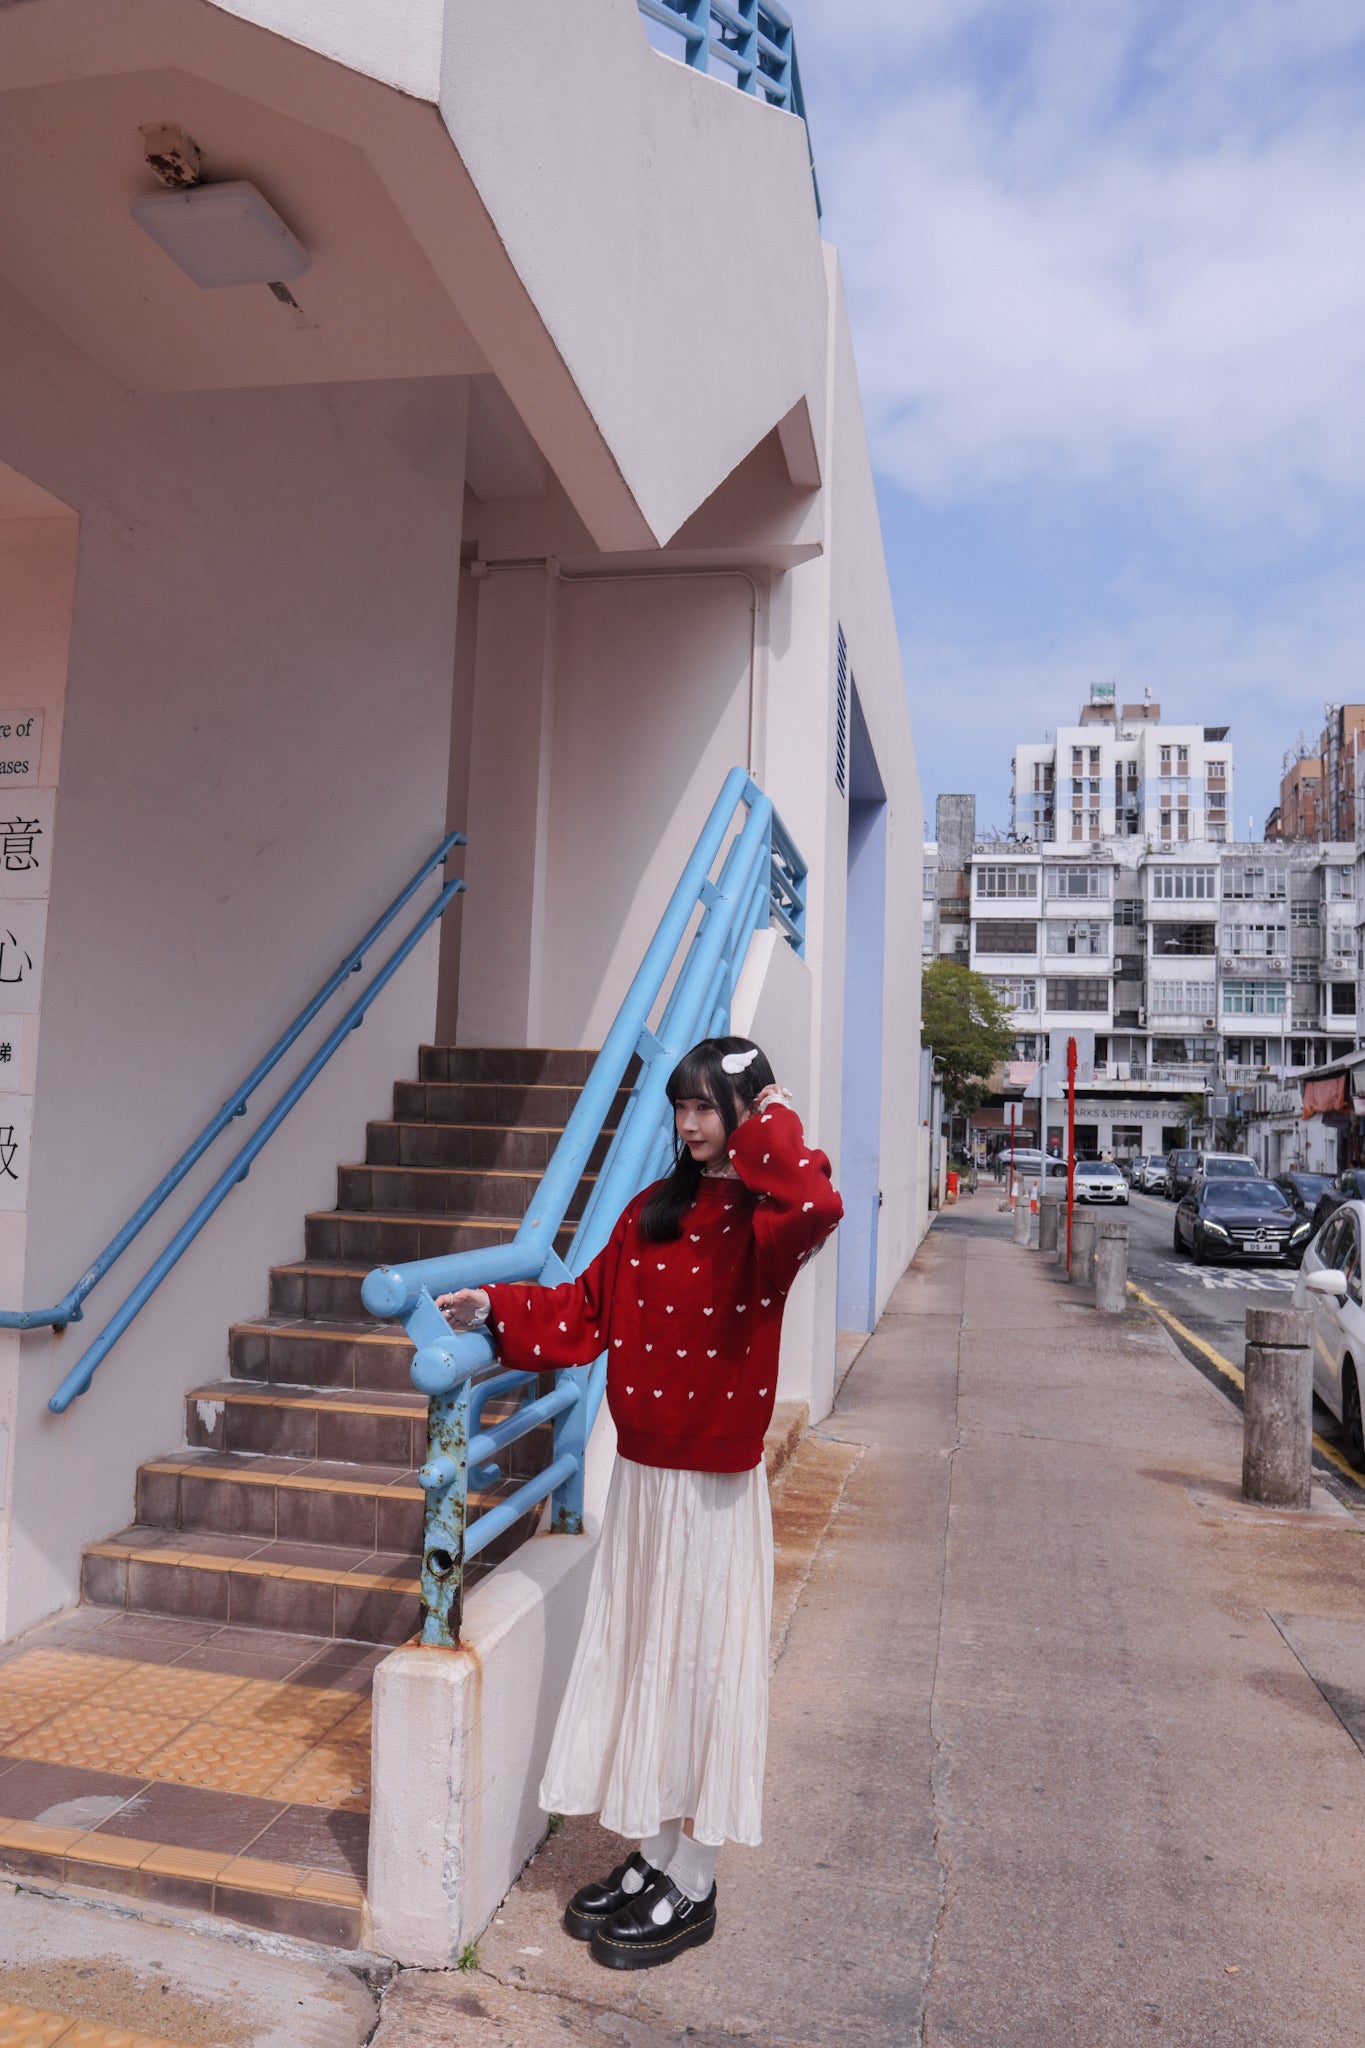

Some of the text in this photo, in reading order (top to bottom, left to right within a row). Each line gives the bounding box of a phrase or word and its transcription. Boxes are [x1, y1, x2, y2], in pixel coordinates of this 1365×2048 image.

[16, 718, 34, 737] of
[0, 816, 43, 871] 意
[1101, 1109, 1109, 1118] &
[1110, 1109, 1160, 1119] SPENCER
[1161, 1110, 1187, 1120] FOO
